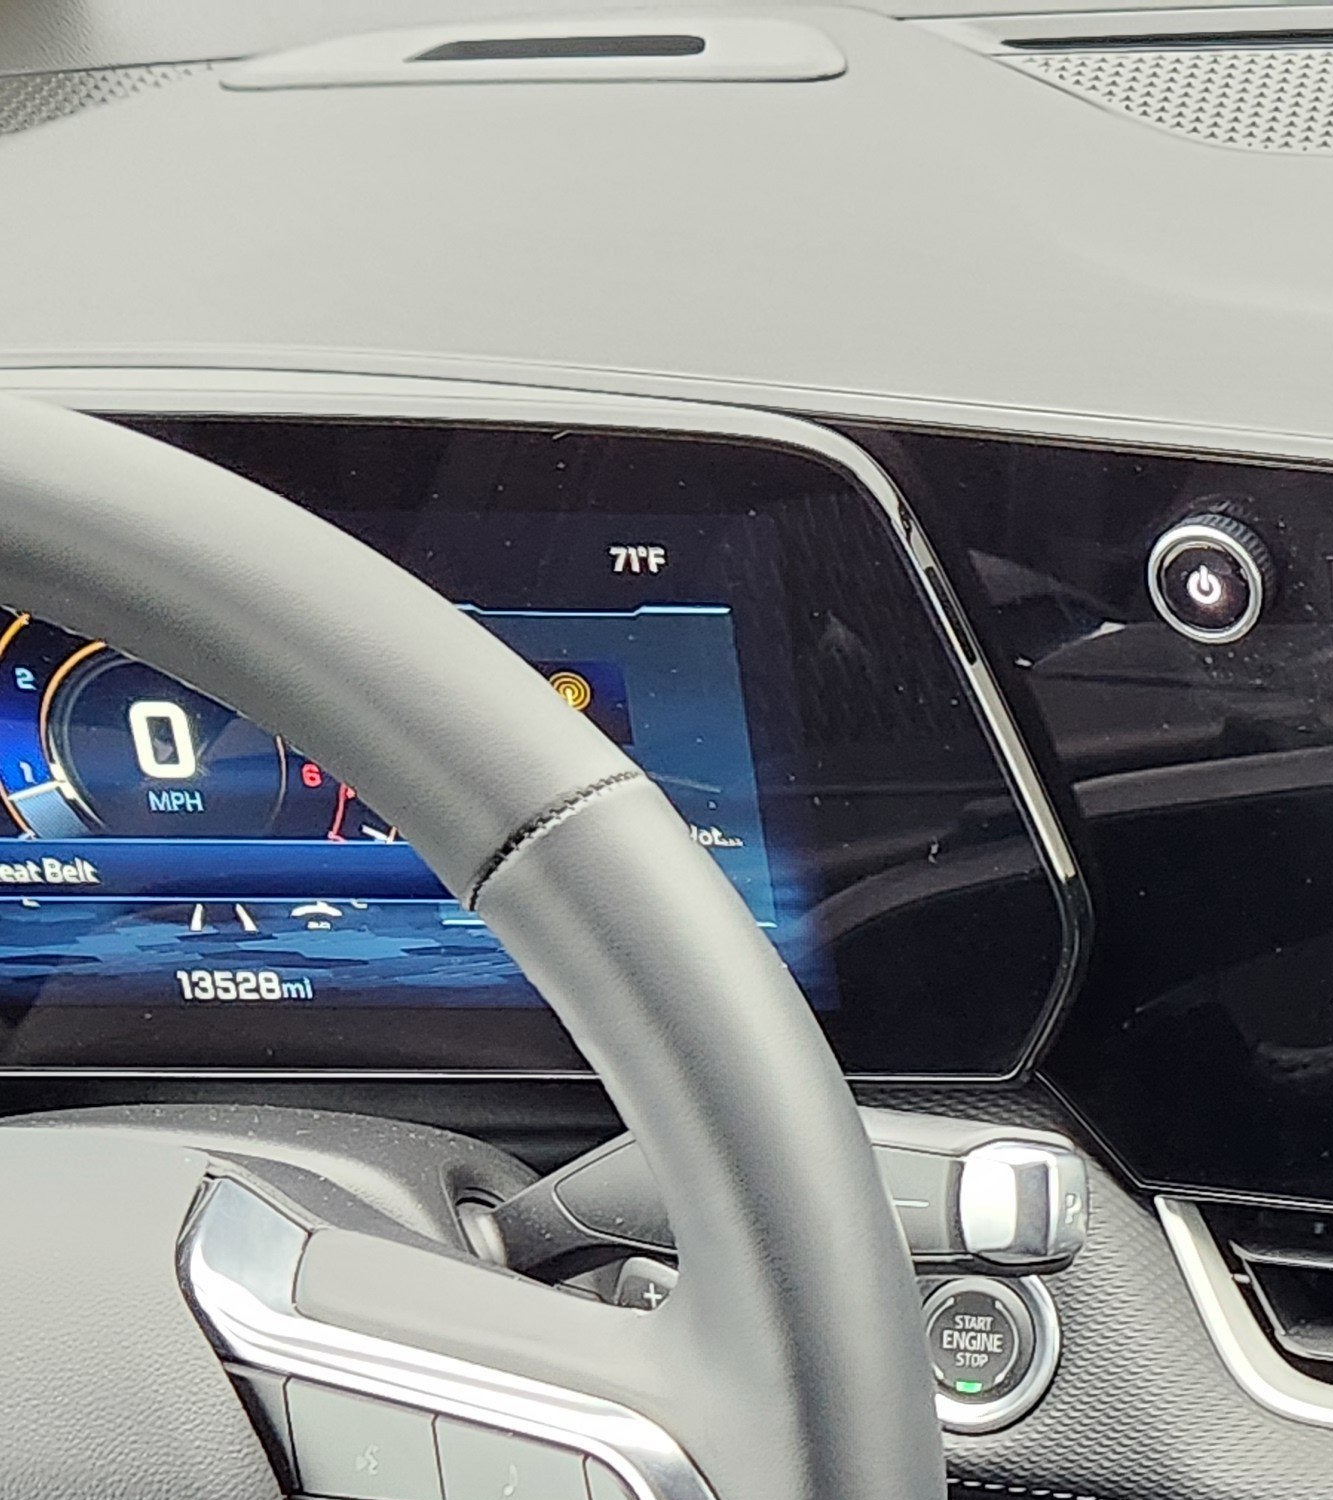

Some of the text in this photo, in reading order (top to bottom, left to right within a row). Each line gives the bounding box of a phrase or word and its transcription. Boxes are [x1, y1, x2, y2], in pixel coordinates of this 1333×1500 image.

[129, 701, 196, 779] 0
[149, 792, 204, 812] MPH
[42, 857, 101, 883] Belt
[954, 1314, 994, 1331] START
[942, 1330, 1003, 1353] ENGINE
[955, 1352, 989, 1367] STOP
